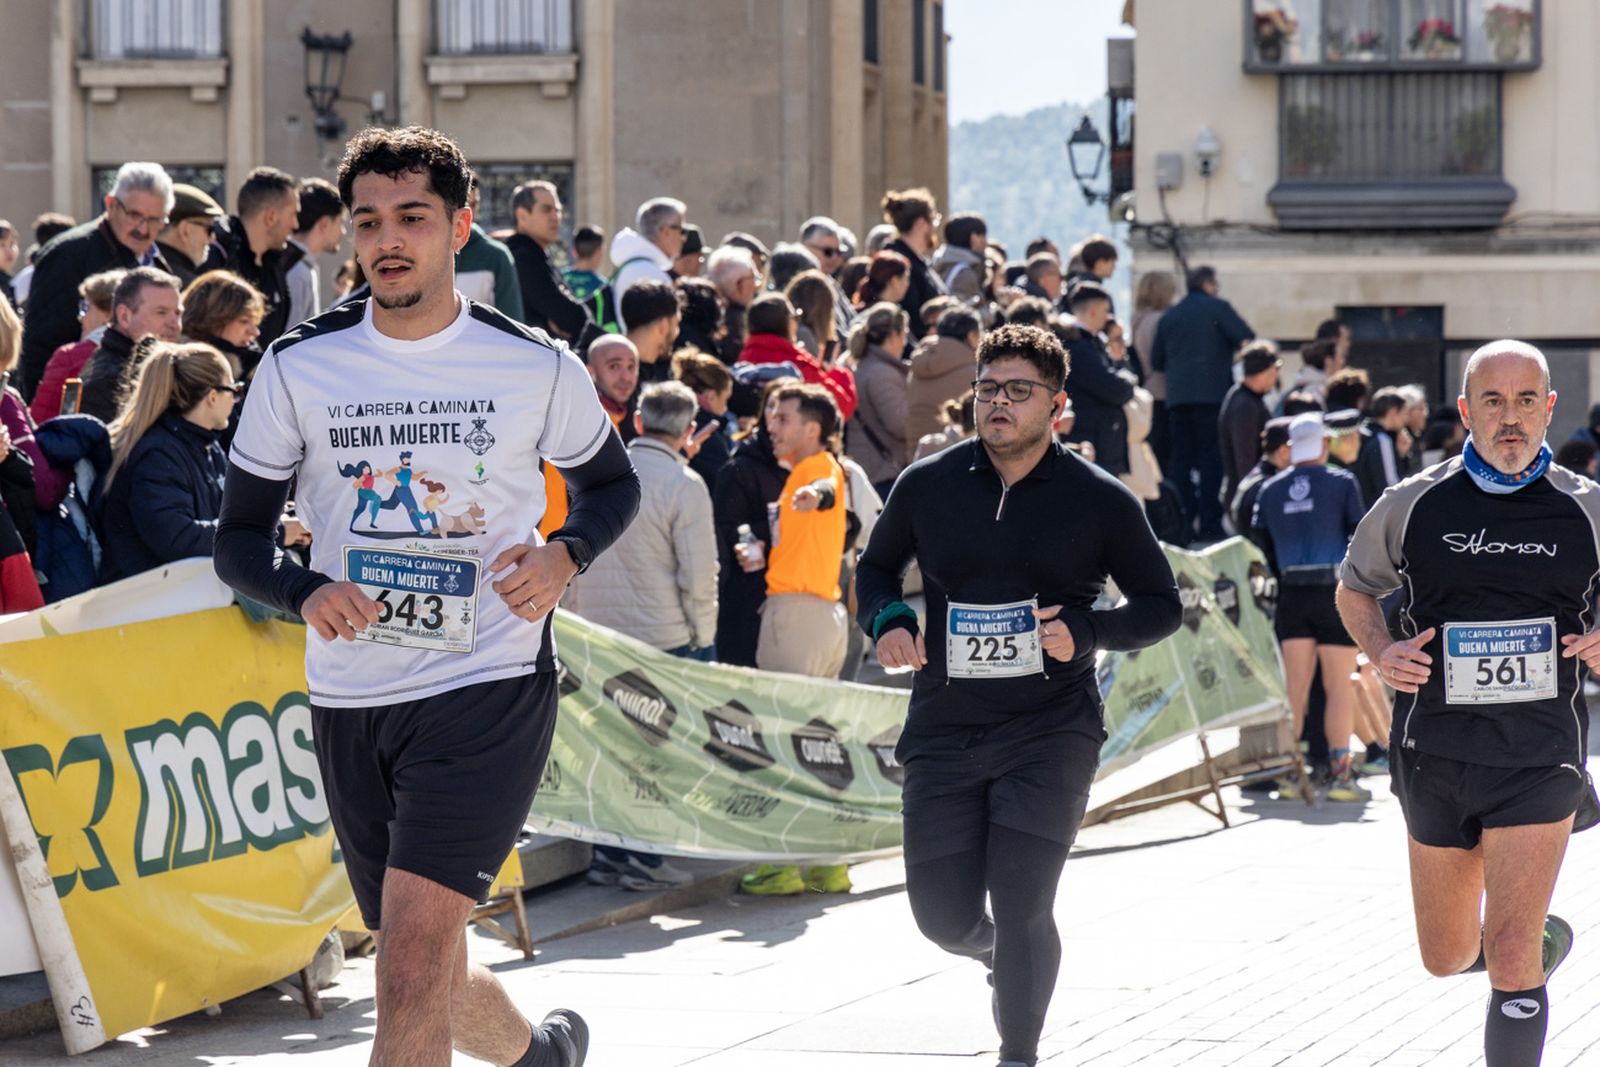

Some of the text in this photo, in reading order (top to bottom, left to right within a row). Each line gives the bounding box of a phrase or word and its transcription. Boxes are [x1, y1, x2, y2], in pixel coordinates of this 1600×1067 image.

[328, 399, 496, 419] VI CARRERA CAMINATA
[328, 422, 461, 449] BUENA MUERTE
[362, 554, 462, 574] VI CARRERA CAMINATA
[362, 566, 439, 590] BUENA MUERTE
[375, 589, 444, 631] 643
[963, 612, 991, 620] CARRERA
[991, 609, 1026, 620] CAMINATA
[956, 621, 1012, 634] BUENA MUERTE
[1459, 627, 1542, 639] VI CARRERA CAMINATA
[966, 636, 1019, 662] 225
[1459, 640, 1526, 654] BUENA MUERTE
[1476, 656, 1527, 686] 561
